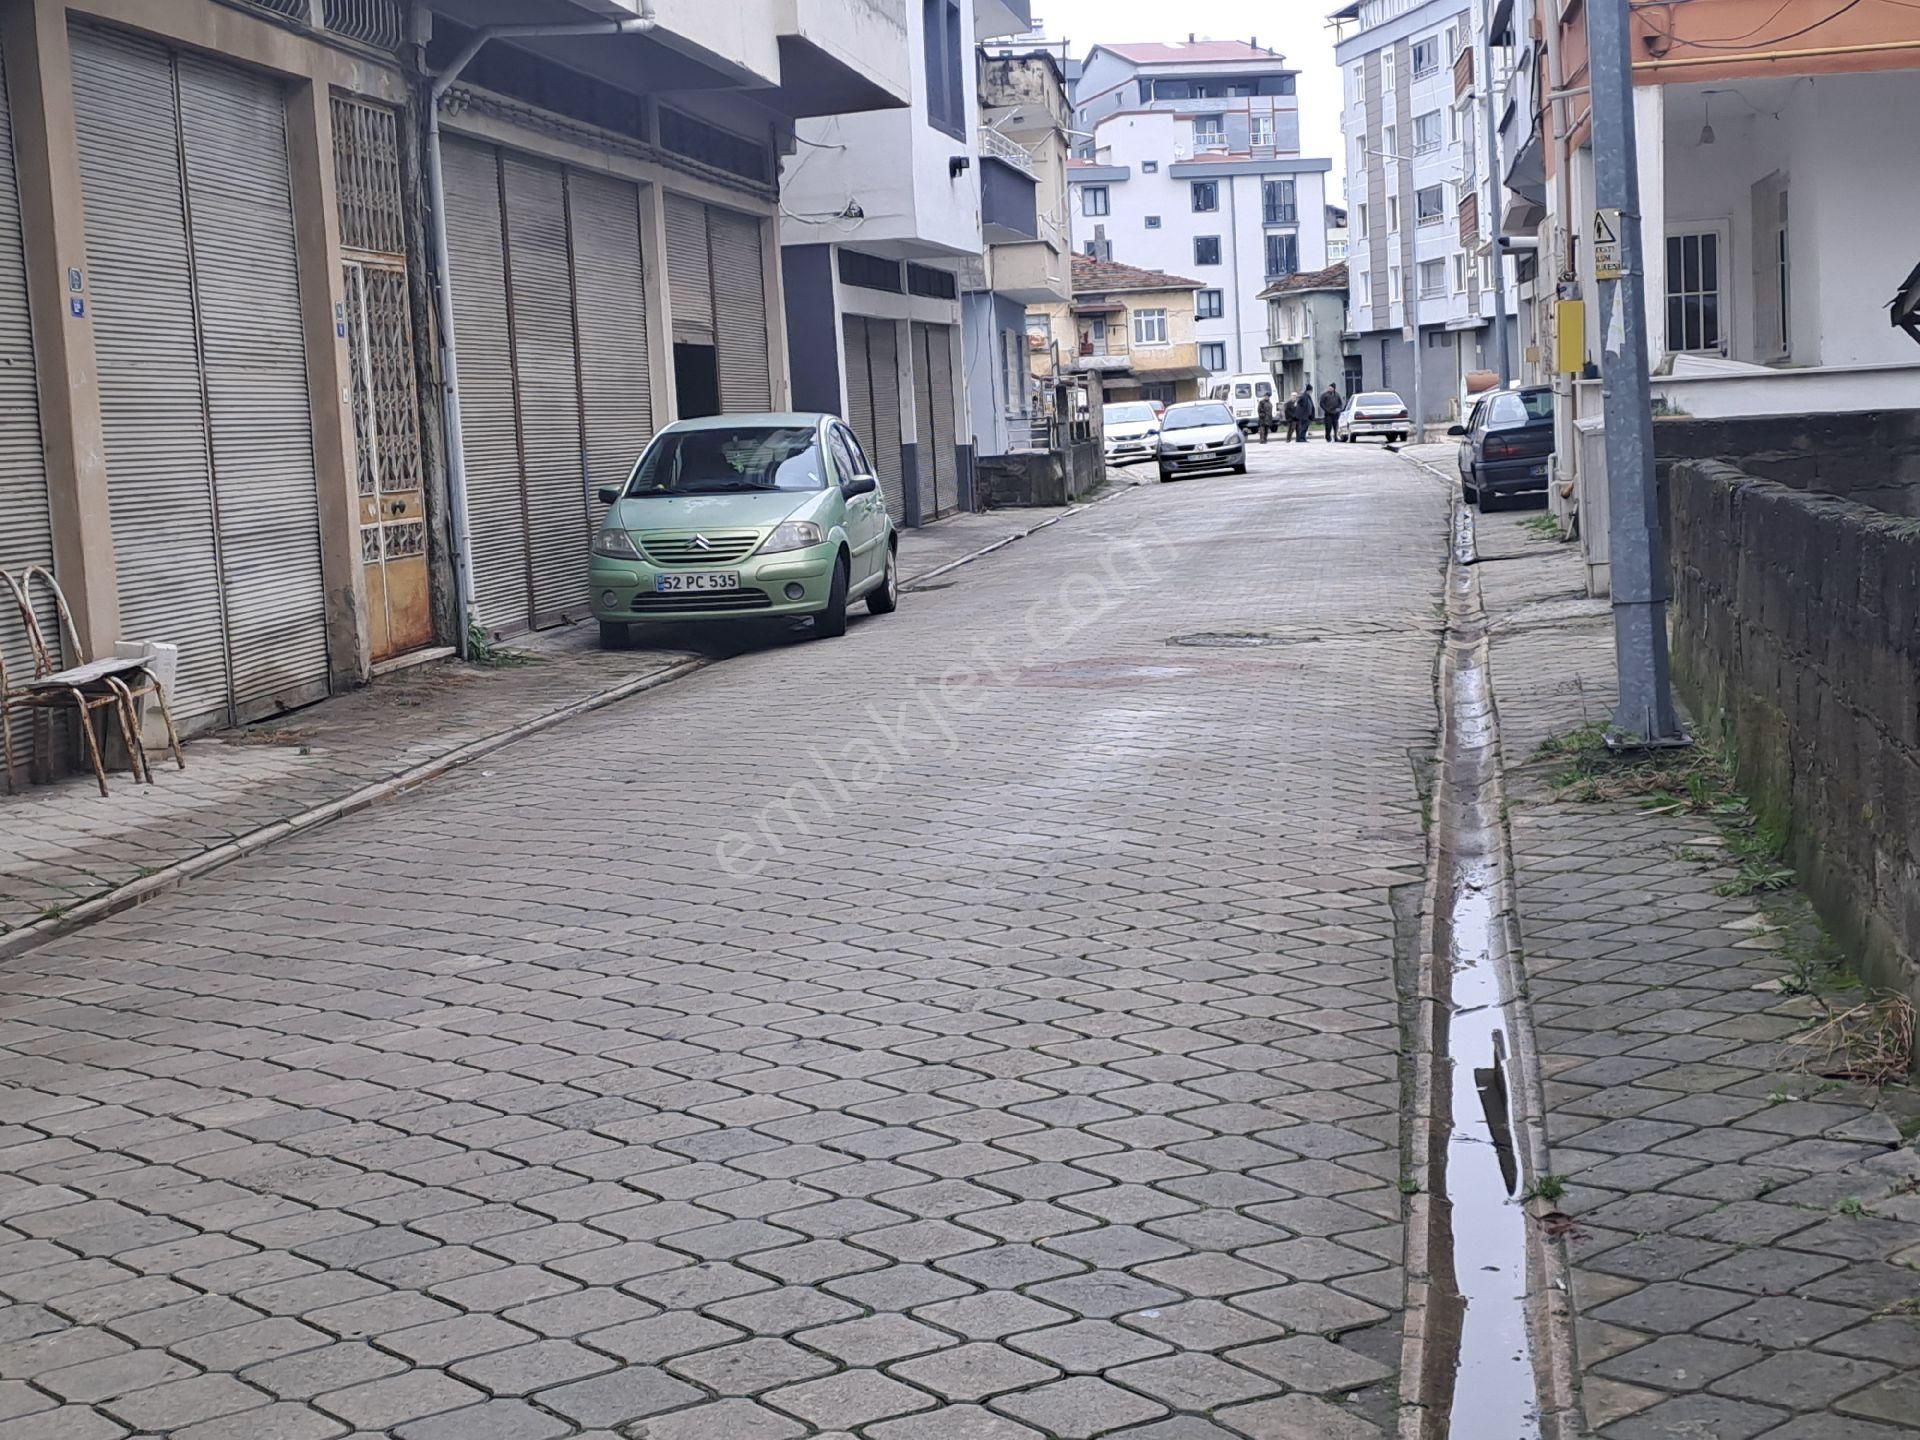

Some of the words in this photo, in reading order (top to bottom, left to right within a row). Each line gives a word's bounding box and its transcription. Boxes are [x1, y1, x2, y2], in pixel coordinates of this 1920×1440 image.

[664, 576, 681, 590] 52
[686, 575, 704, 589] PC
[709, 574, 737, 588] 535
